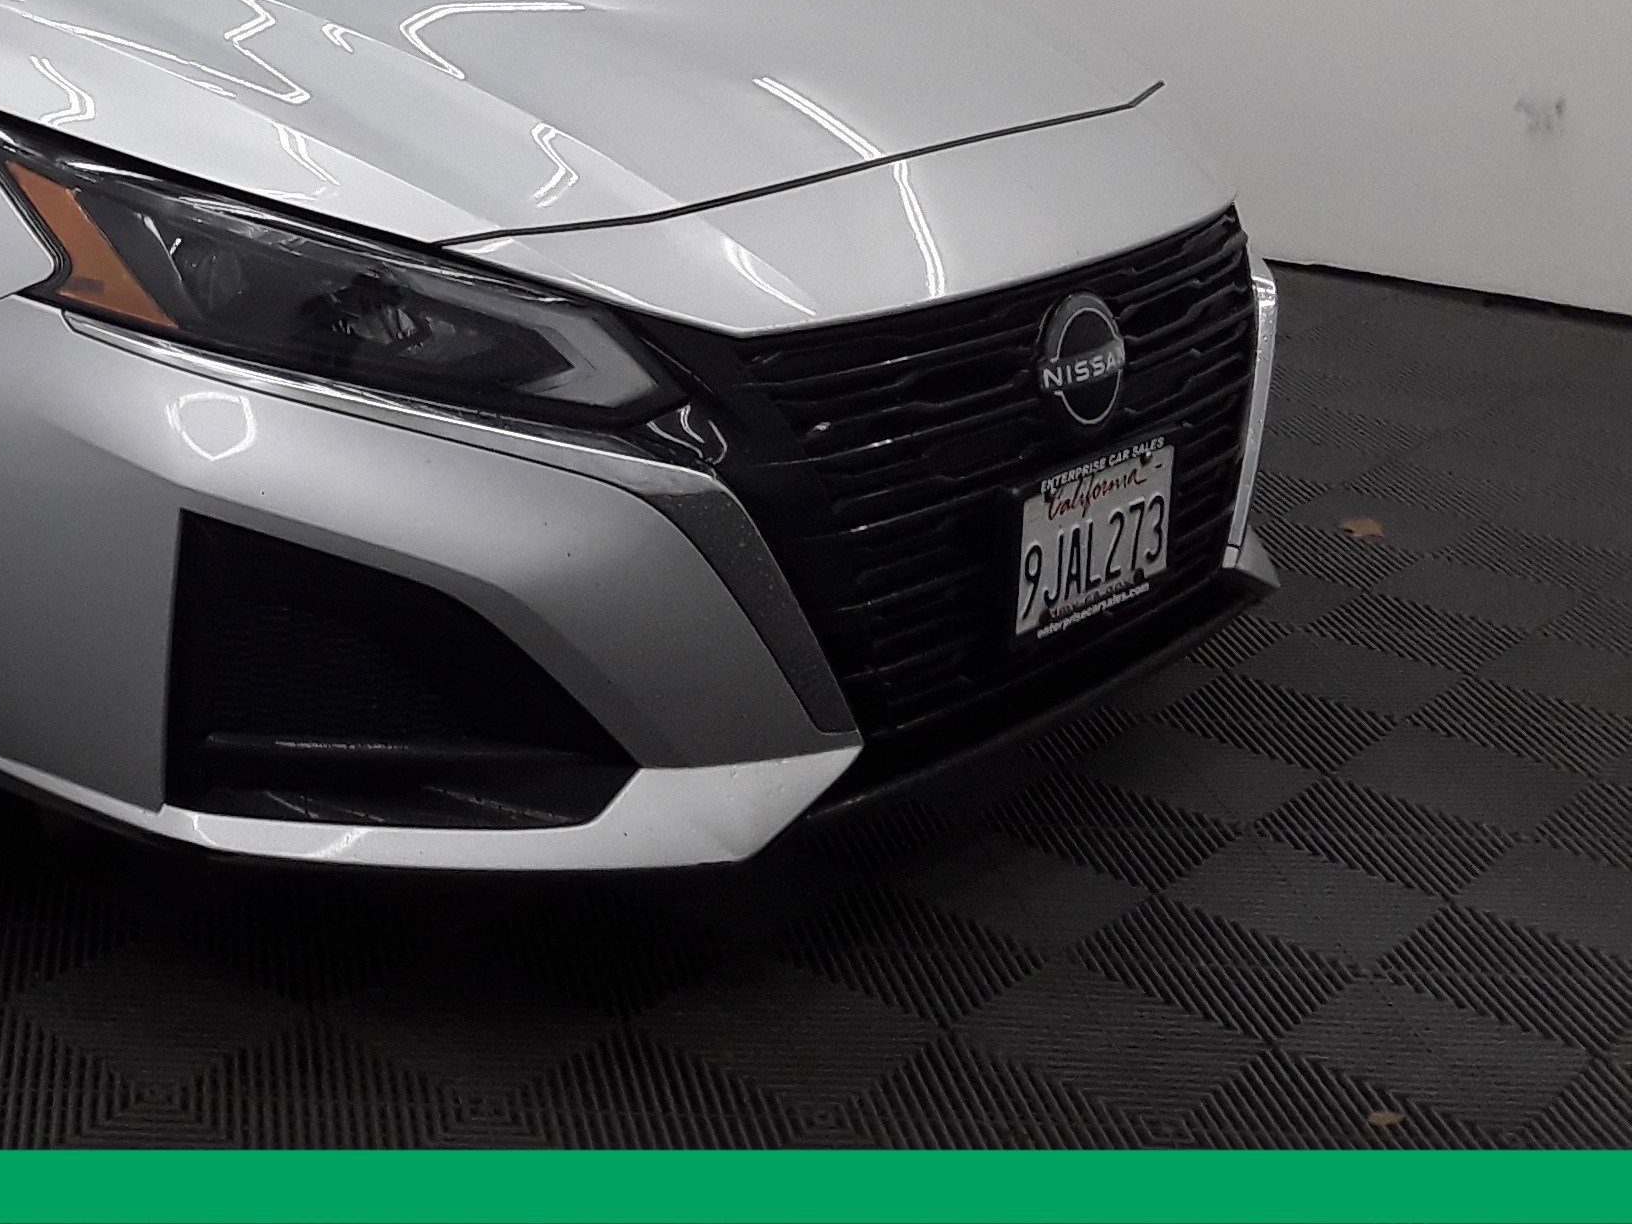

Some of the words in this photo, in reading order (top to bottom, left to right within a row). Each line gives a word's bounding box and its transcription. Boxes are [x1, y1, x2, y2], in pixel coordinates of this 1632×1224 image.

[1040, 457, 1107, 494] ENTERPRISE
[1108, 447, 1130, 465] CAR
[1131, 436, 1165, 458] SALES
[1045, 466, 1147, 520] California
[1021, 494, 1165, 620] 9JAL273
